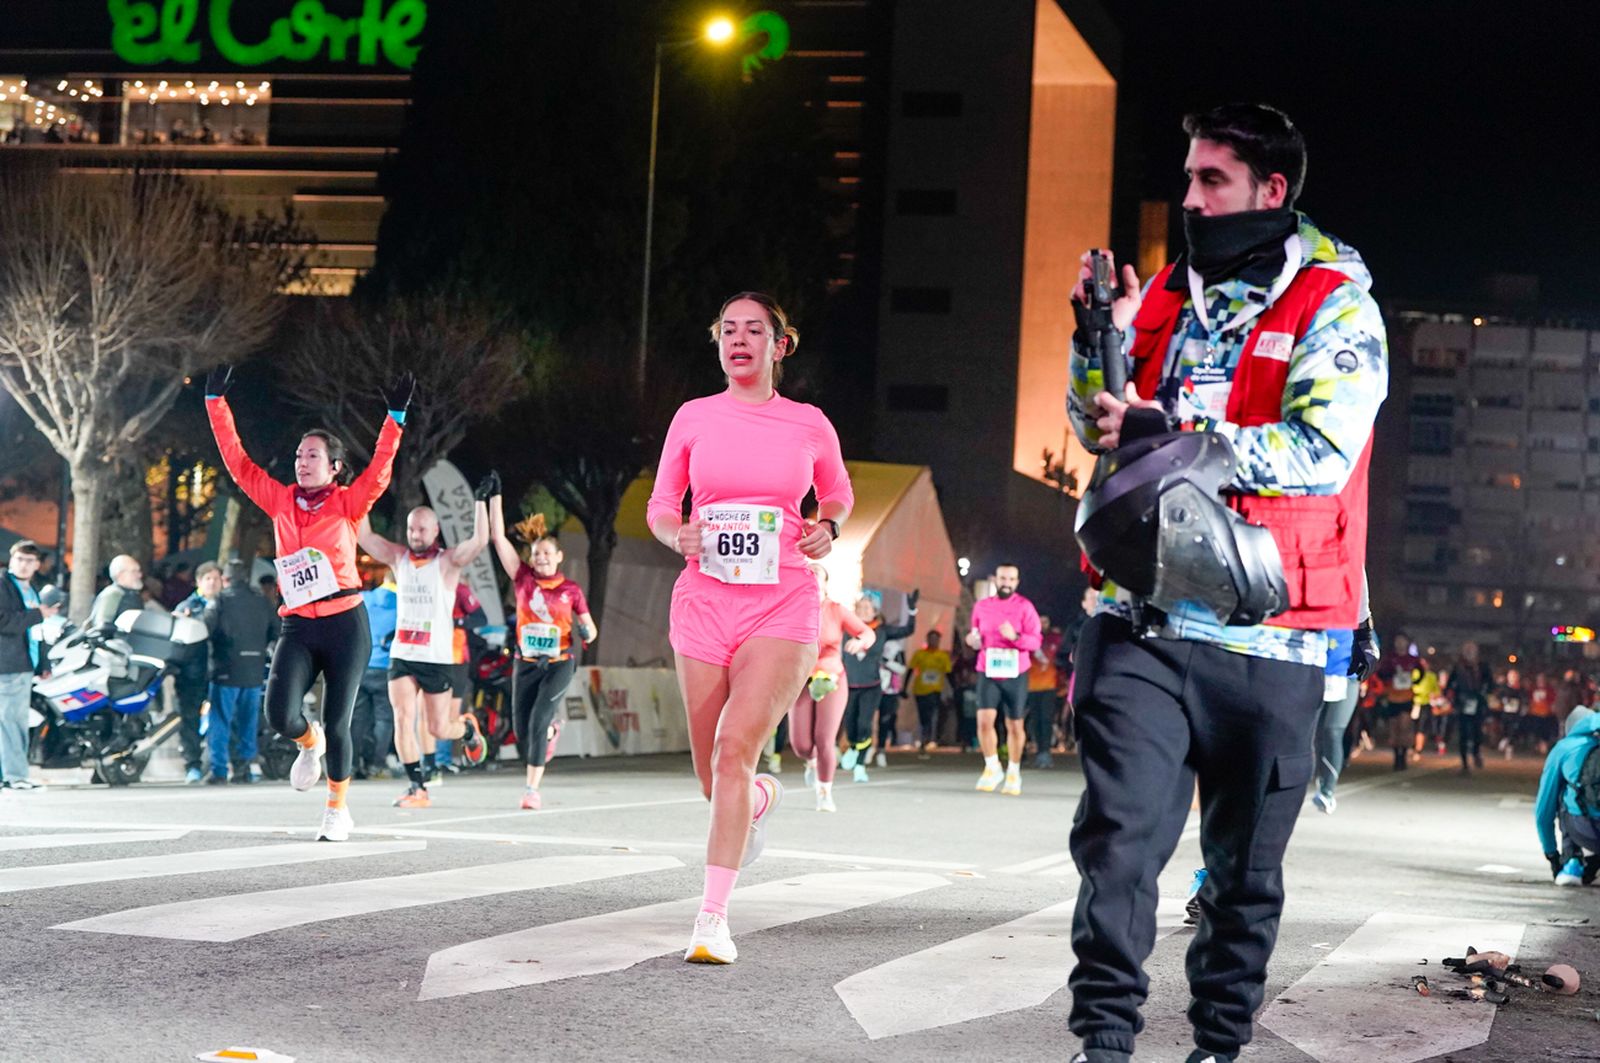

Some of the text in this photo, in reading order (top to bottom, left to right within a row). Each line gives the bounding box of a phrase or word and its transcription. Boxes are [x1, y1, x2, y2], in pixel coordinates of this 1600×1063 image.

[209, 0, 427, 69] Corte
[740, 513, 750, 521] DE
[452, 484, 494, 591] JAPMASA
[717, 532, 760, 556] 693
[291, 564, 319, 589] 7347
